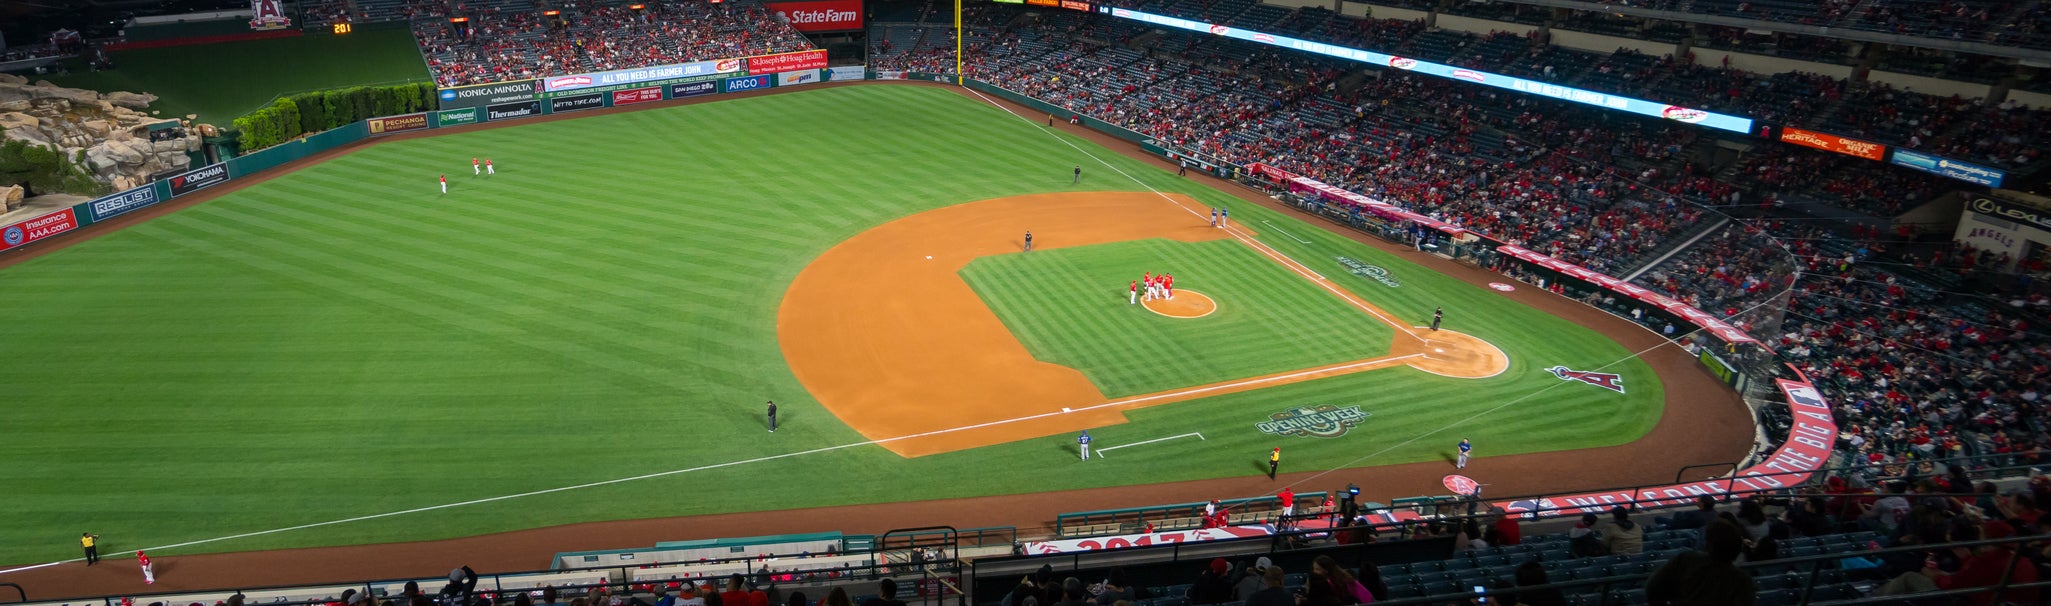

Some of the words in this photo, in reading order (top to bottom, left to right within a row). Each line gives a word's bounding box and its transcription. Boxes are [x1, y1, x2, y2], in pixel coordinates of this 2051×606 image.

[334, 23, 351, 33] 2:01
[602, 74, 615, 83] ALL
[616, 72, 629, 81] YOU
[630, 70, 647, 80] NEED
[649, 69, 656, 78] IS
[657, 66, 683, 77] FARMER
[684, 65, 701, 74] JOHN
[459, 88, 492, 98] KONICA
[494, 84, 532, 94] MINOLTA
[730, 78, 758, 90] ARCO
[574, 97, 602, 105] TIRE.COM
[448, 111, 474, 120] National
[490, 108, 531, 119] Thermador
[386, 117, 425, 126] PECHANGA
[1782, 134, 1829, 148] HERITAGE
[1838, 138, 1877, 150] ORGANIC
[1847, 144, 1869, 154] MILK
[185, 166, 224, 183] YOKOHAMA
[97, 198, 122, 212] RES
[124, 190, 150, 204] LIST
[26, 213, 66, 230] Insurance
[30, 222, 70, 240] AAA.com
[1968, 228, 2014, 248] ANGELS
[1259, 414, 1325, 433] OPENING
[1321, 406, 1366, 420] WEEK
[1796, 410, 1830, 422] A
[1794, 422, 1832, 450] BIG
[1766, 448, 1820, 478] THE
